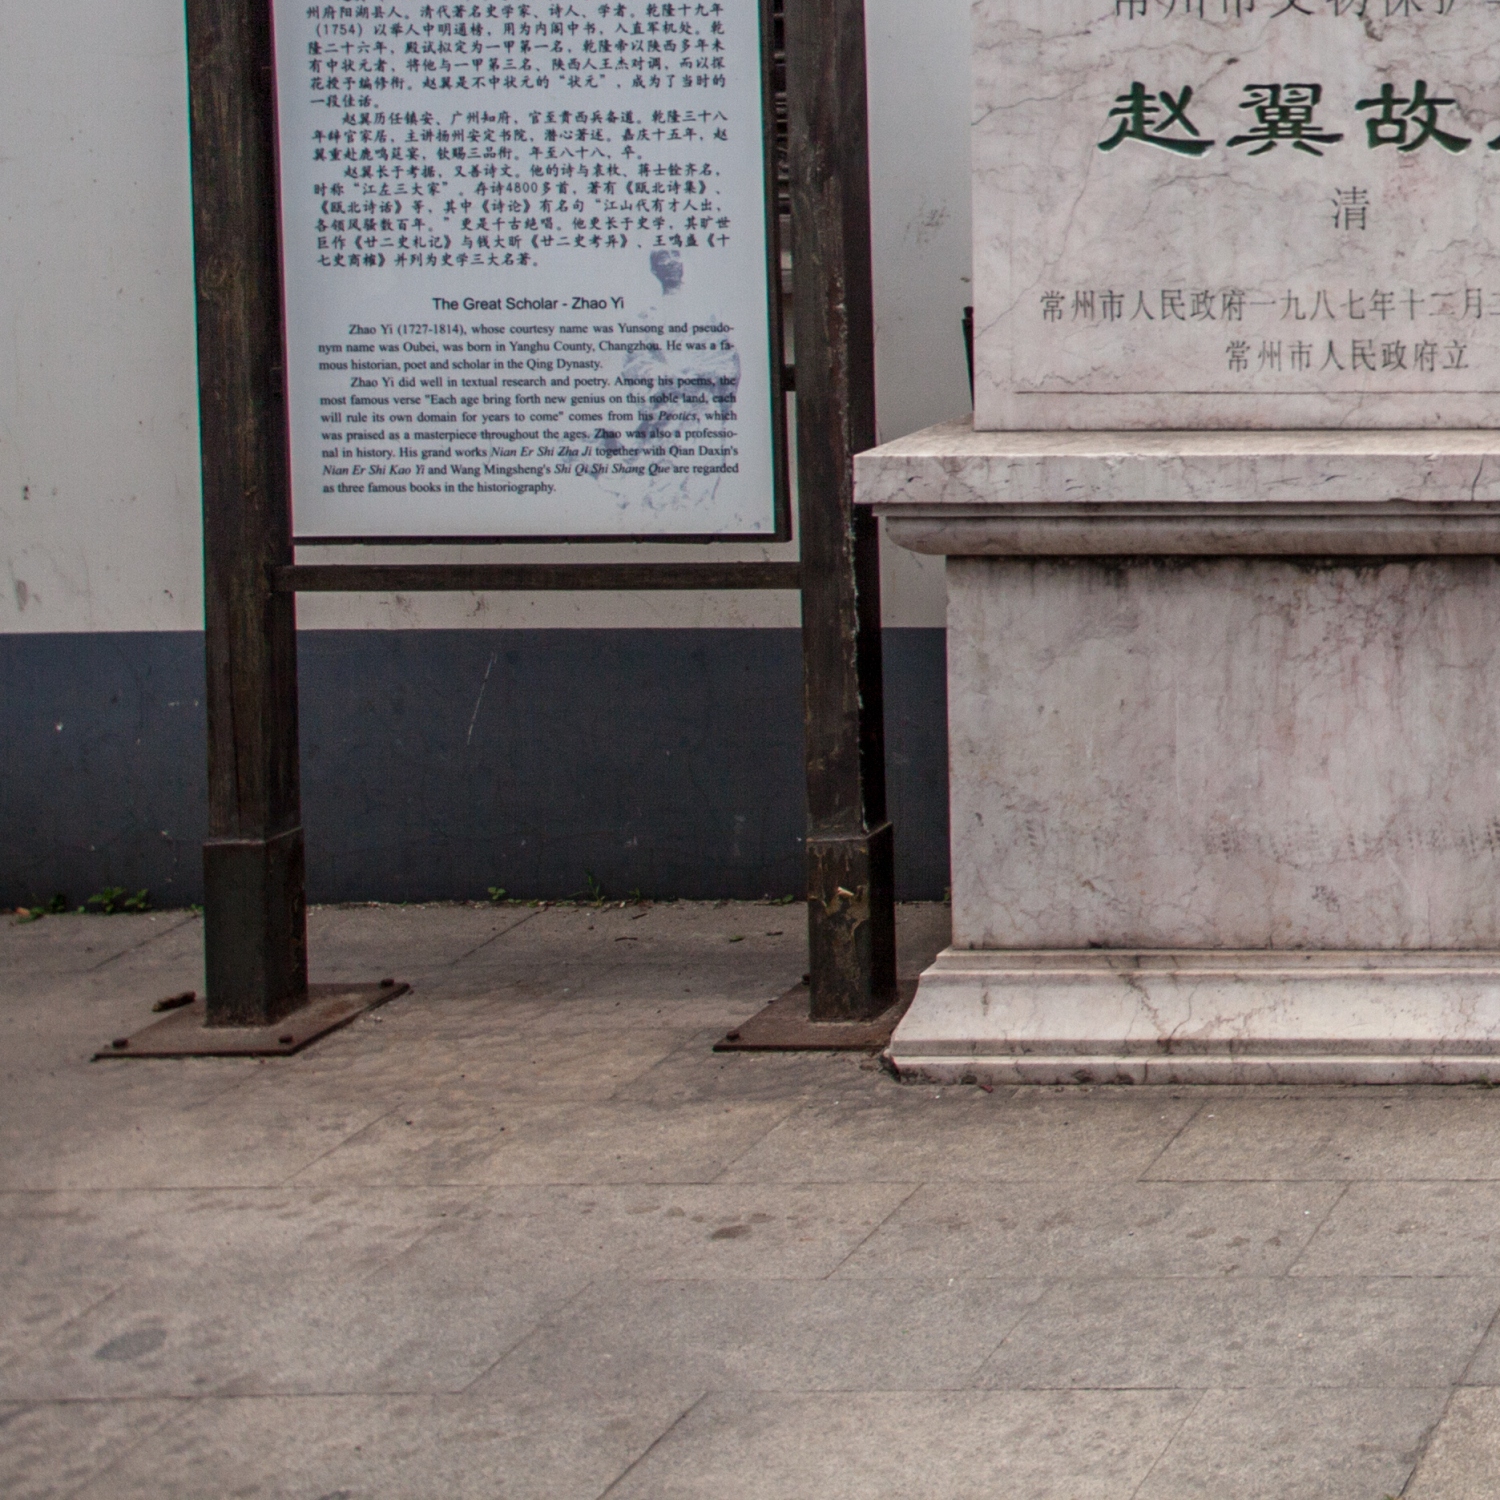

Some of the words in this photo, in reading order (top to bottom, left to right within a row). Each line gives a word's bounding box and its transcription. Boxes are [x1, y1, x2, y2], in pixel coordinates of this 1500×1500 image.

[310, 94, 381, 109] 一段佳话。
[1330, 186, 1370, 232] 清
[432, 297, 459, 311] The
[462, 297, 502, 310] Great
[505, 297, 558, 310] Scholar
[571, 297, 608, 310] Zhao
[610, 297, 625, 310] Yi
[348, 323, 377, 335] Zhao
[380, 323, 394, 335] Yi
[396, 323, 467, 338] (1727-1814),
[470, 323, 506, 335] whose
[508, 323, 555, 338] courtesy
[558, 325, 589, 334] name
[592, 325, 614, 334] was
[617, 322, 665, 337] Yunsong
[668, 322, 689, 334] and
[691, 322, 734, 337] pseudo-
[318, 344, 343, 356] nym
[345, 344, 376, 353] name
[378, 344, 400, 353] was
[402, 341, 439, 354] Oubei,
[442, 343, 464, 352] was
[466, 340, 492, 352] born
[495, 340, 506, 352] in
[509, 340, 550, 355] Yanghu
[552, 340, 596, 355] County,
[666, 339, 682, 351] He
[685, 342, 707, 351] was
[709, 342, 717, 351] a
[720, 339, 735, 351] fa-
[1225, 339, 1470, 372] 常州市人民政府立
[318, 362, 348, 371] mous
[350, 358, 401, 372] historian,
[402, 358, 427, 373] poet
[429, 358, 450, 370] and
[451, 358, 490, 370] scholar
[493, 358, 505, 369] in
[506, 357, 524, 369] the
[526, 357, 554, 372] Qing
[556, 357, 604, 372] Dynasty.
[350, 376, 379, 388] Zhao
[382, 376, 395, 388] Yi
[398, 376, 416, 388] did
[419, 376, 443, 388] well
[446, 376, 458, 387] in
[460, 375, 498, 387] textual
[501, 375, 547, 387] research
[550, 375, 571, 387] and
[573, 375, 612, 390] poetry.
[614, 375, 655, 390] Among
[657, 375, 674, 387] his
[718, 374, 736, 386] the
[319, 394, 347, 406] most
[350, 393, 390, 405] famous
[392, 396, 422, 405] verse
[424, 393, 458, 405] "Each
[460, 396, 480, 408] age
[482, 393, 512, 408] bring
[514, 393, 542, 405] forth
[544, 396, 567, 405] new
[570, 393, 606, 408] genius
[608, 395, 623, 404] on
[625, 392, 646, 404] this
[320, 411, 342, 423] will
[346, 411, 368, 423] rule
[372, 411, 386, 423] its
[388, 414, 413, 422] own
[416, 410, 458, 422] domain
[461, 410, 477, 422] for
[481, 413, 510, 425] years
[514, 410, 526, 422] to
[529, 410, 564, 422] come"
[568, 413, 604, 422] comes
[607, 410, 634, 422] from
[637, 410, 654, 421] his
[704, 409, 738, 421] which
[320, 432, 343, 441] was
[345, 428, 386, 444] praised
[388, 431, 400, 440] as
[403, 431, 411, 440] a
[413, 428, 478, 443] masterpiece
[479, 428, 540, 443] throughout
[542, 428, 560, 440] the
[562, 431, 590, 443] ages.
[593, 427, 622, 439] Zhao
[625, 430, 647, 439] was
[649, 427, 673, 439] also
[673, 430, 682, 439] a
[684, 427, 738, 442] professio-
[321, 446, 339, 458] nal
[341, 446, 354, 458] in
[355, 446, 395, 461] history.
[398, 446, 418, 458] His
[420, 446, 452, 461] grand
[454, 446, 488, 458] works
[489, 445, 518, 457] Nian
[520, 445, 534, 457] Er
[536, 445, 555, 457] Shi
[556, 445, 580, 457] Zha
[580, 445, 593, 457] Ji
[595, 445, 641, 460] together
[640, 445, 666, 456] with
[668, 444, 696, 456] Qian
[698, 444, 739, 456] Daxin's
[322, 464, 350, 476] Nian
[351, 464, 366, 476] Er
[368, 464, 386, 476] Shi
[388, 464, 412, 475] Kao
[415, 463, 425, 475] Yi
[427, 463, 448, 475] and
[450, 463, 481, 478] Wang
[483, 463, 552, 478] Mingsheng's
[554, 463, 572, 475] Shi
[574, 463, 589, 475] Qi
[588, 463, 609, 474] Shi
[611, 462, 646, 478] Shang
[648, 462, 671, 474] Que
[672, 465, 690, 474] are
[692, 462, 740, 477] regarded
[322, 485, 335, 493] as
[336, 481, 365, 493] three
[367, 481, 407, 493] famous
[408, 481, 442, 493] books
[444, 481, 456, 493] in
[457, 481, 474, 493] the
[476, 481, 556, 496] historiography.
